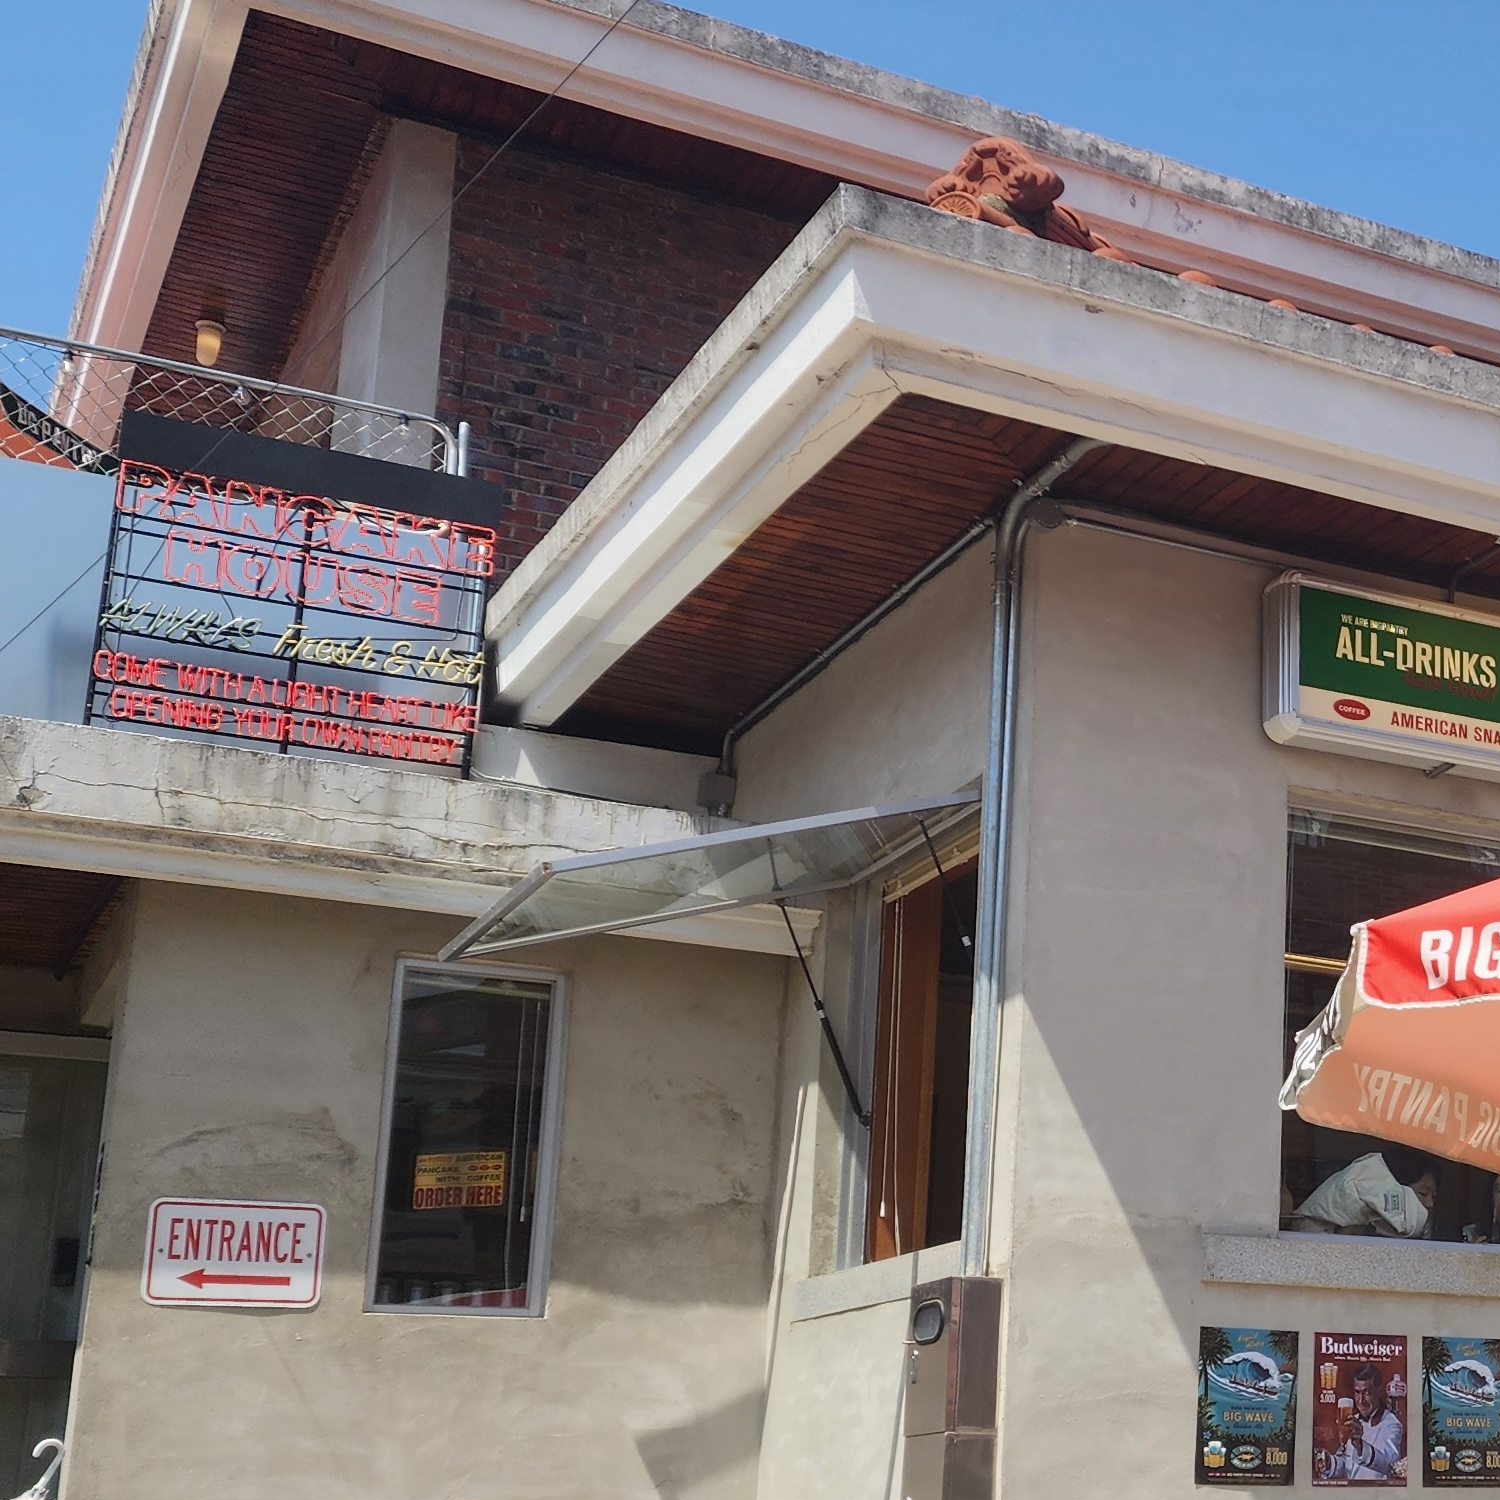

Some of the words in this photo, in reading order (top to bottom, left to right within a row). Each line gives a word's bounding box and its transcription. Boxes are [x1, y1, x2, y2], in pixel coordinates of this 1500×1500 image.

[116, 458, 496, 577] PANCAKE
[163, 529, 443, 625] HOUSE
[1340, 613, 1354, 626] WE
[1354, 616, 1370, 630] ARE
[99, 597, 263, 650] ALWAYS
[272, 623, 376, 672] Fresh
[383, 640, 412, 674] &
[415, 645, 487, 685] Hot
[1335, 625, 1498, 690] ALL-DRINKS
[93, 649, 168, 690] COME
[176, 664, 244, 700] WITH
[244, 675, 268, 705] A
[270, 678, 347, 716] LIGHT
[348, 690, 423, 727] HEART
[428, 701, 481, 735] LIKE
[1337, 704, 1367, 717] COFFEE
[109, 690, 224, 732] OPENING
[232, 706, 295, 745] YOUR
[301, 718, 362, 755] OWN
[364, 728, 459, 765] PANTRY
[1390, 711, 1468, 740] AMERICAN
[415, 1187, 463, 1208] ORDER
[466, 1185, 502, 1205] HERE
[167, 1217, 306, 1264] ENTRANCE
[1321, 1337, 1402, 1357] Budweiser
[1223, 1411, 1241, 1422] BIG
[1245, 1412, 1275, 1423] WAVE
[1446, 1417, 1463, 1427] BIG
[1466, 1418, 1492, 1428] WAVE
[1265, 1452, 1288, 1467] 8,000
